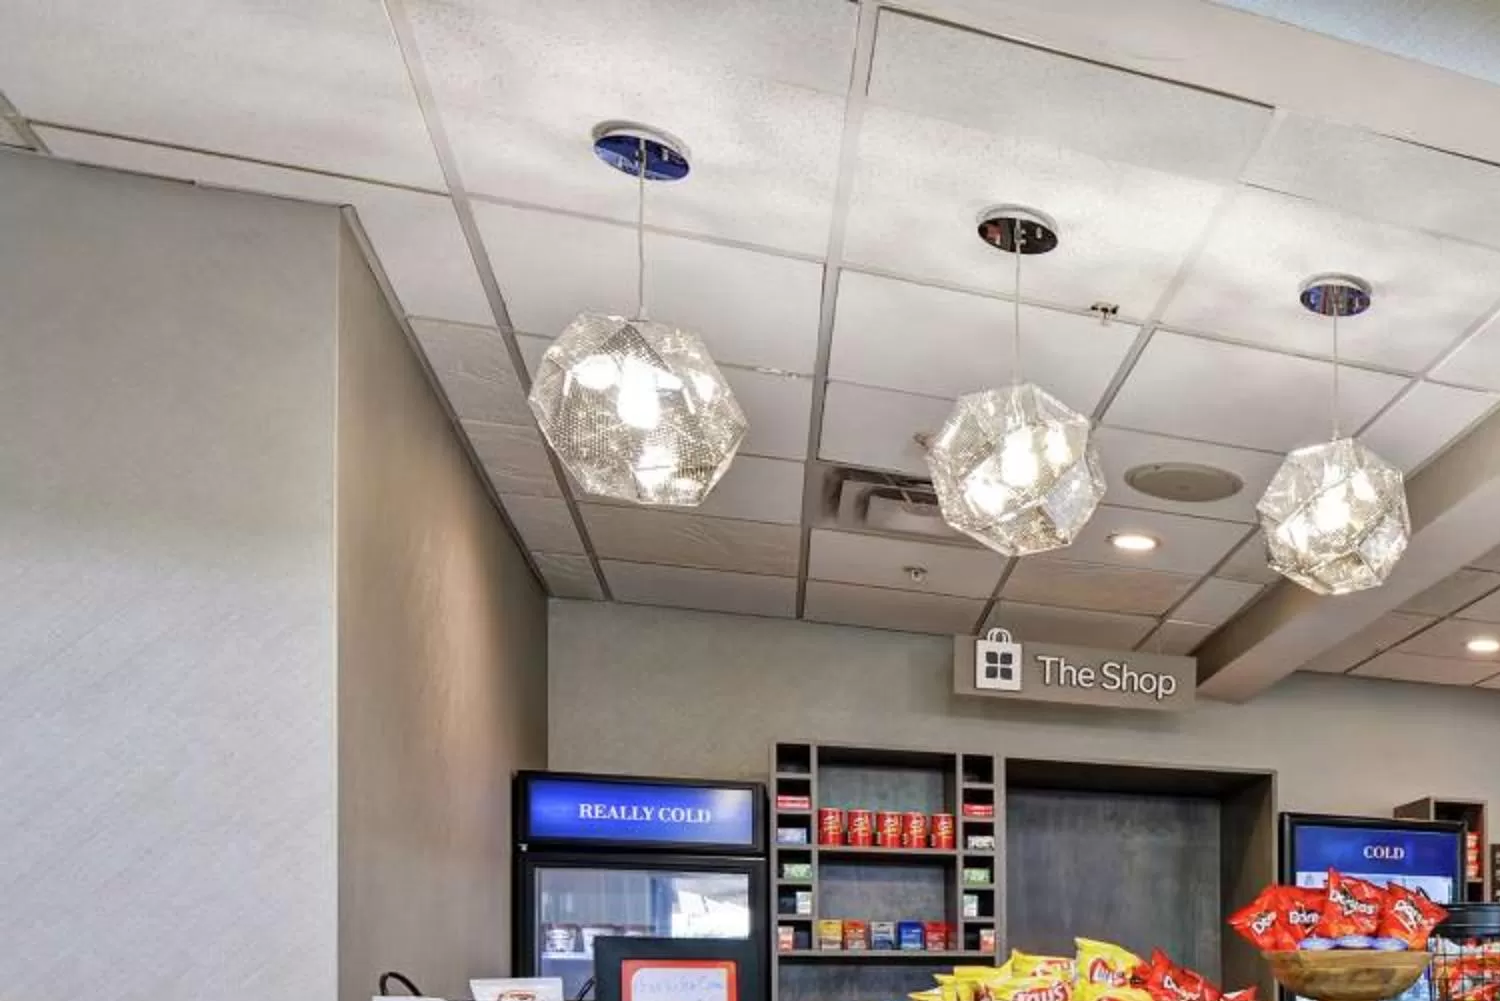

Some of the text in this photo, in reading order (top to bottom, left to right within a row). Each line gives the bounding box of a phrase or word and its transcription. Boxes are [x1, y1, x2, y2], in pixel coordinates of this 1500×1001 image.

[1036, 655, 1176, 699] The Shop
[578, 802, 712, 823] REALLY COLD
[1362, 845, 1405, 860] COLD
